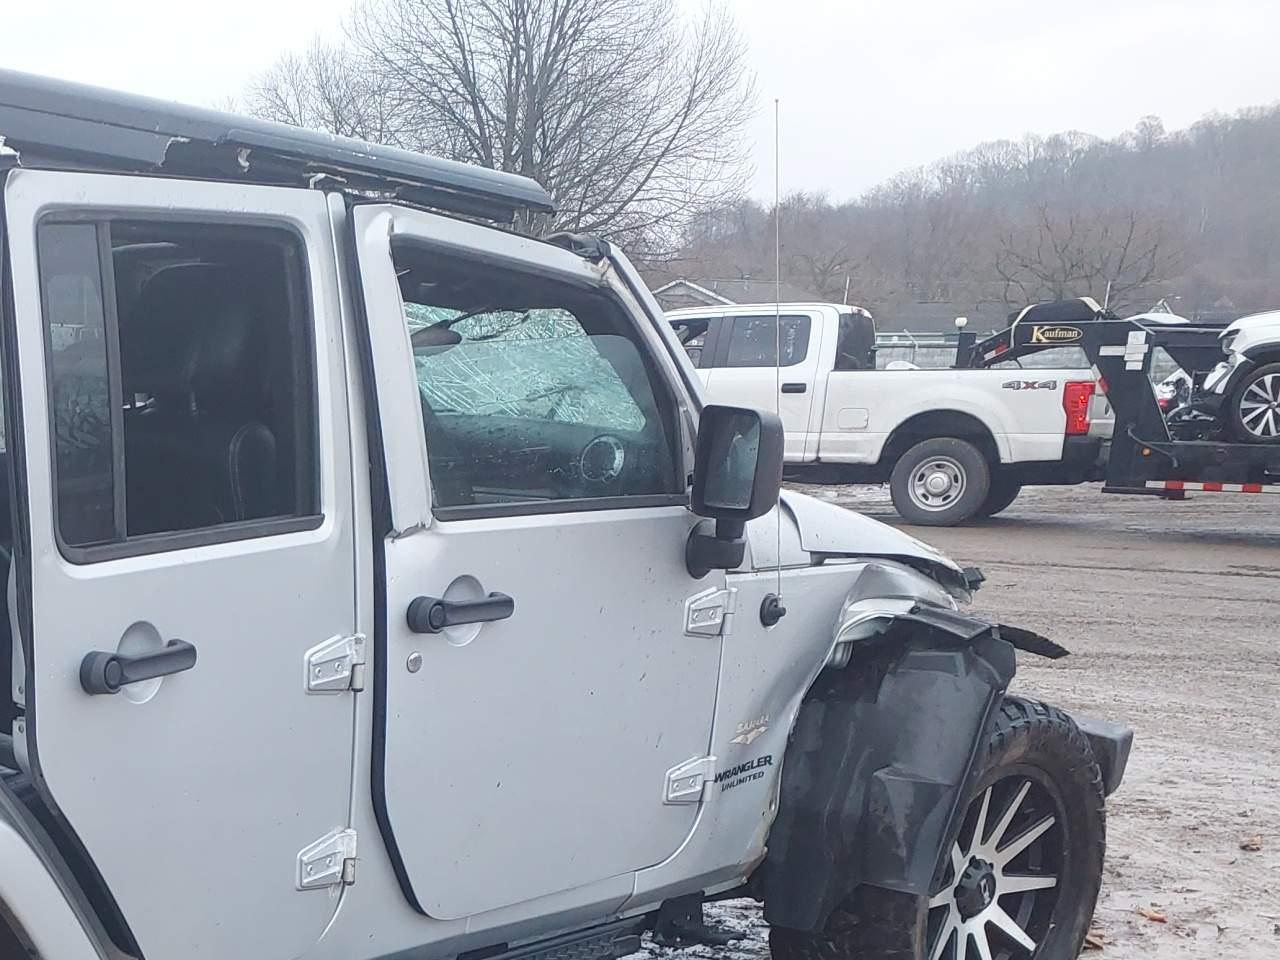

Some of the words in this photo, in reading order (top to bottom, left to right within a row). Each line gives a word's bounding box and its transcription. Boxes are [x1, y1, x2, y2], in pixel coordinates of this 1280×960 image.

[1030, 325, 1078, 343] Kaufman
[714, 755, 773, 783] WRANGLER
[721, 771, 765, 792] UNLIMITED
